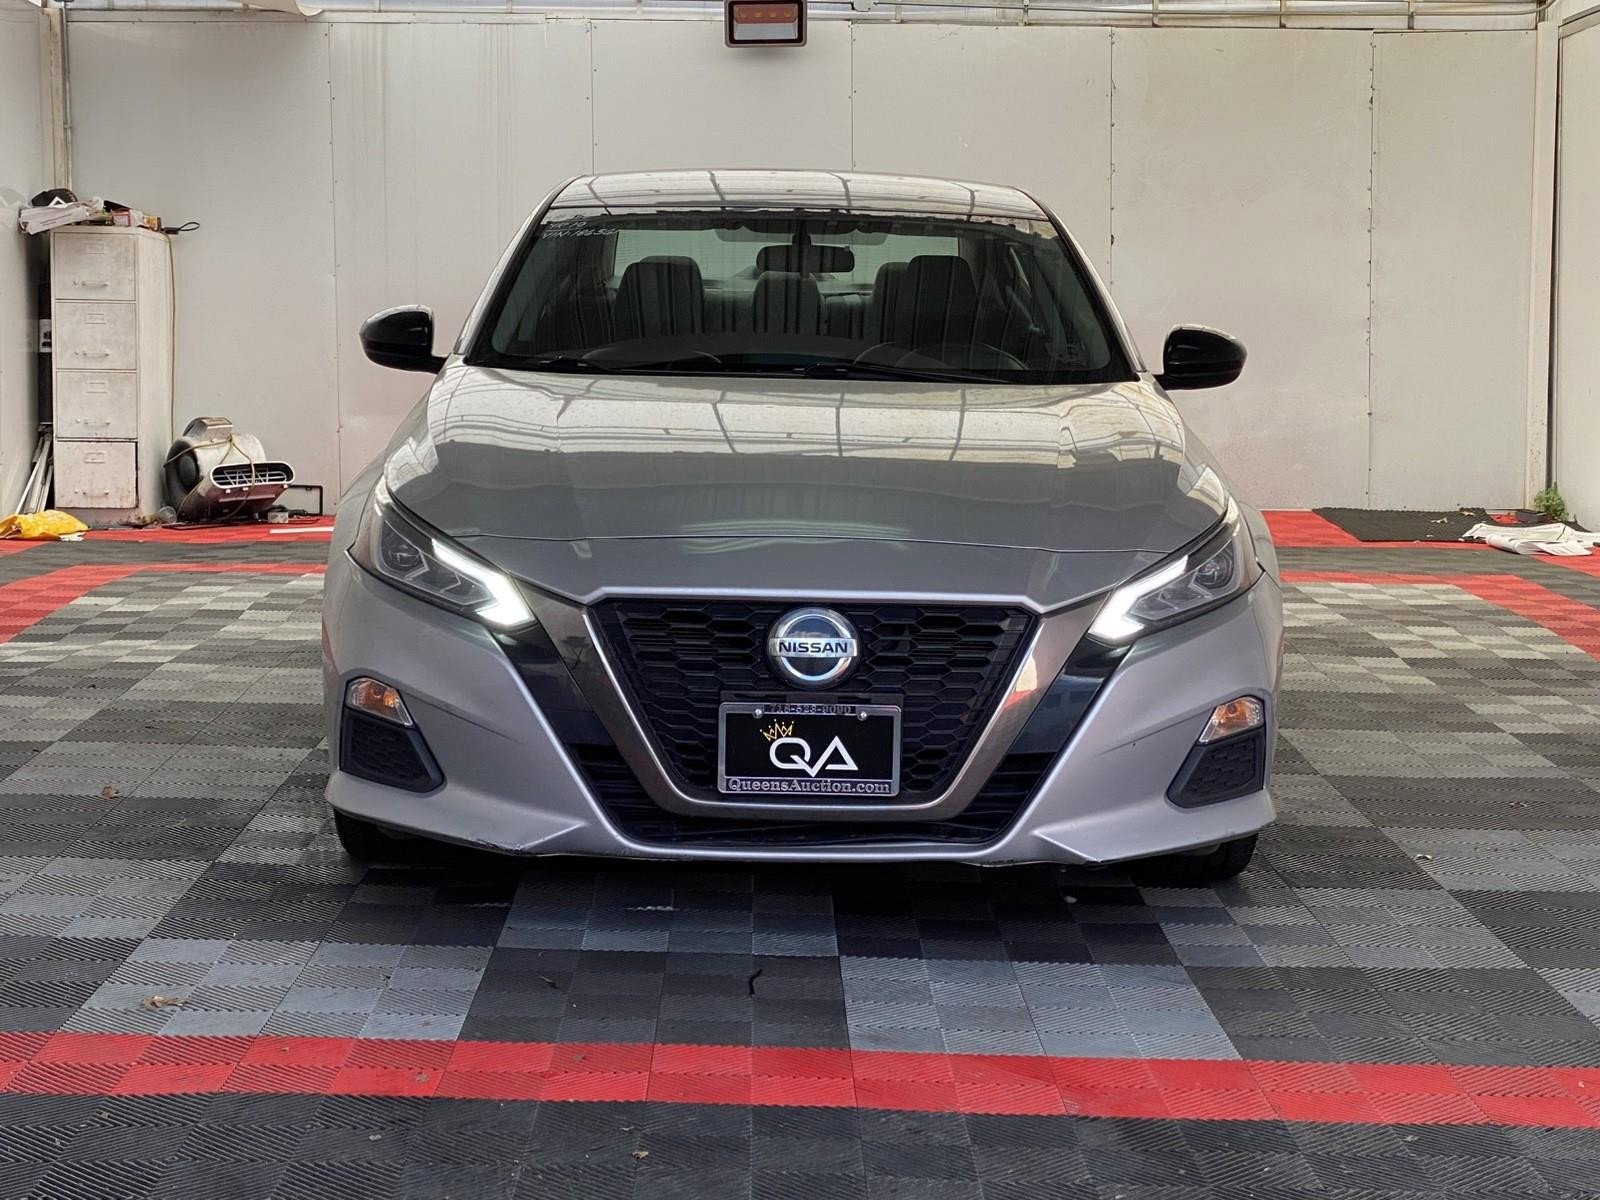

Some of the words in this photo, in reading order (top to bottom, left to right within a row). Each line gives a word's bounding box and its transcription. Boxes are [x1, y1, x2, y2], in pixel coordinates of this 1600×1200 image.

[778, 641, 848, 653] NISSAN
[769, 735, 859, 778] QA
[727, 777, 890, 793] QueensAuction.com
